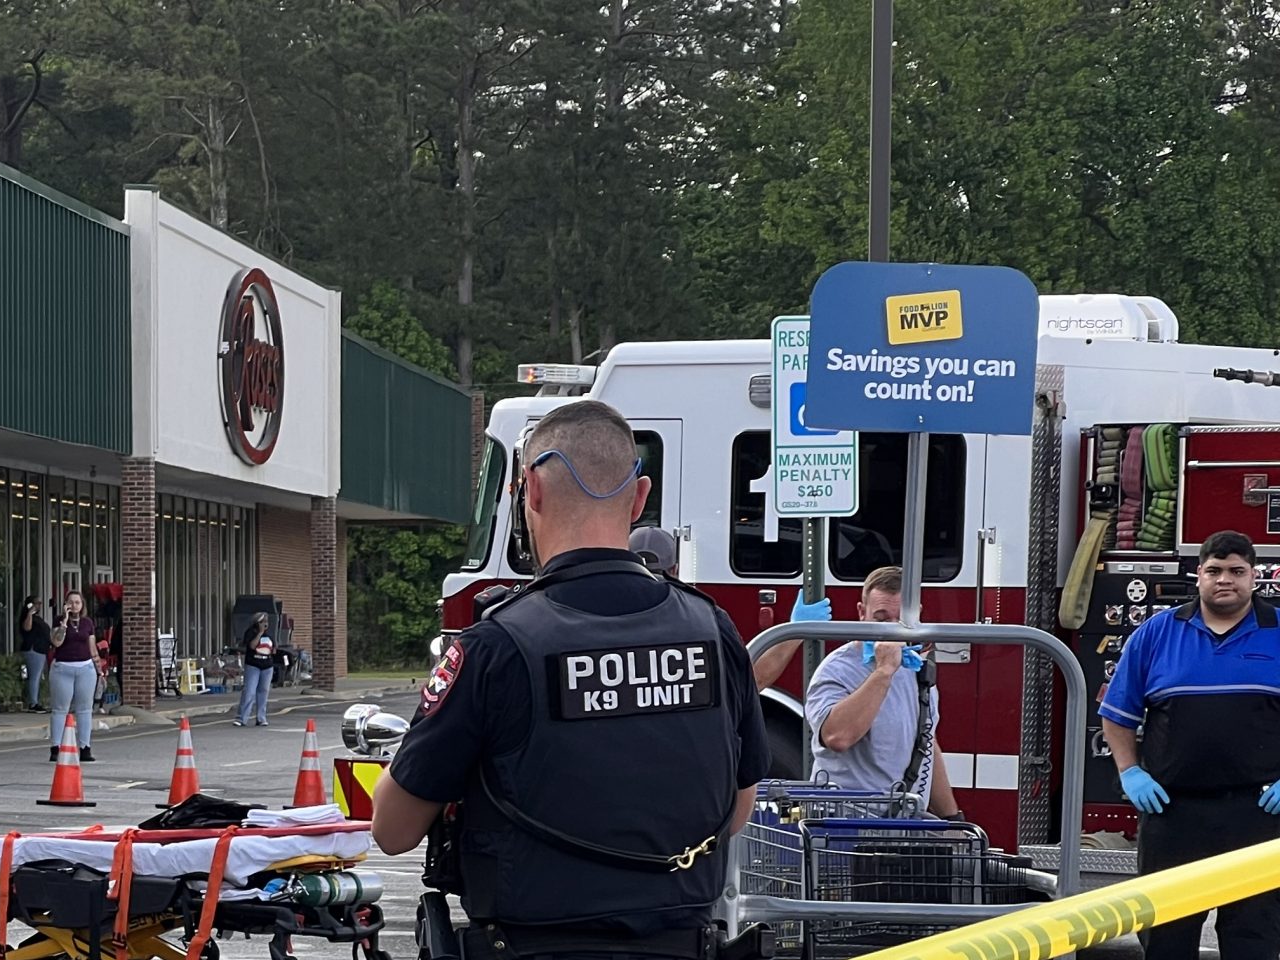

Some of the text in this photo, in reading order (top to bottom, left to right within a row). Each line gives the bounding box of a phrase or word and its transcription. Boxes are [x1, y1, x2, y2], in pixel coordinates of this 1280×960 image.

[900, 302, 948, 313] FOOD LION
[901, 310, 948, 330] MVP
[1048, 316, 1123, 331] nightscan
[827, 348, 1016, 379] Savings you can
[864, 380, 975, 402] count on!
[779, 453, 852, 466] MAXIMUM
[780, 469, 851, 481] PENALTY
[798, 485, 833, 497] $250
[566, 647, 706, 690] POLICE
[583, 683, 694, 712] K9 UNIT
